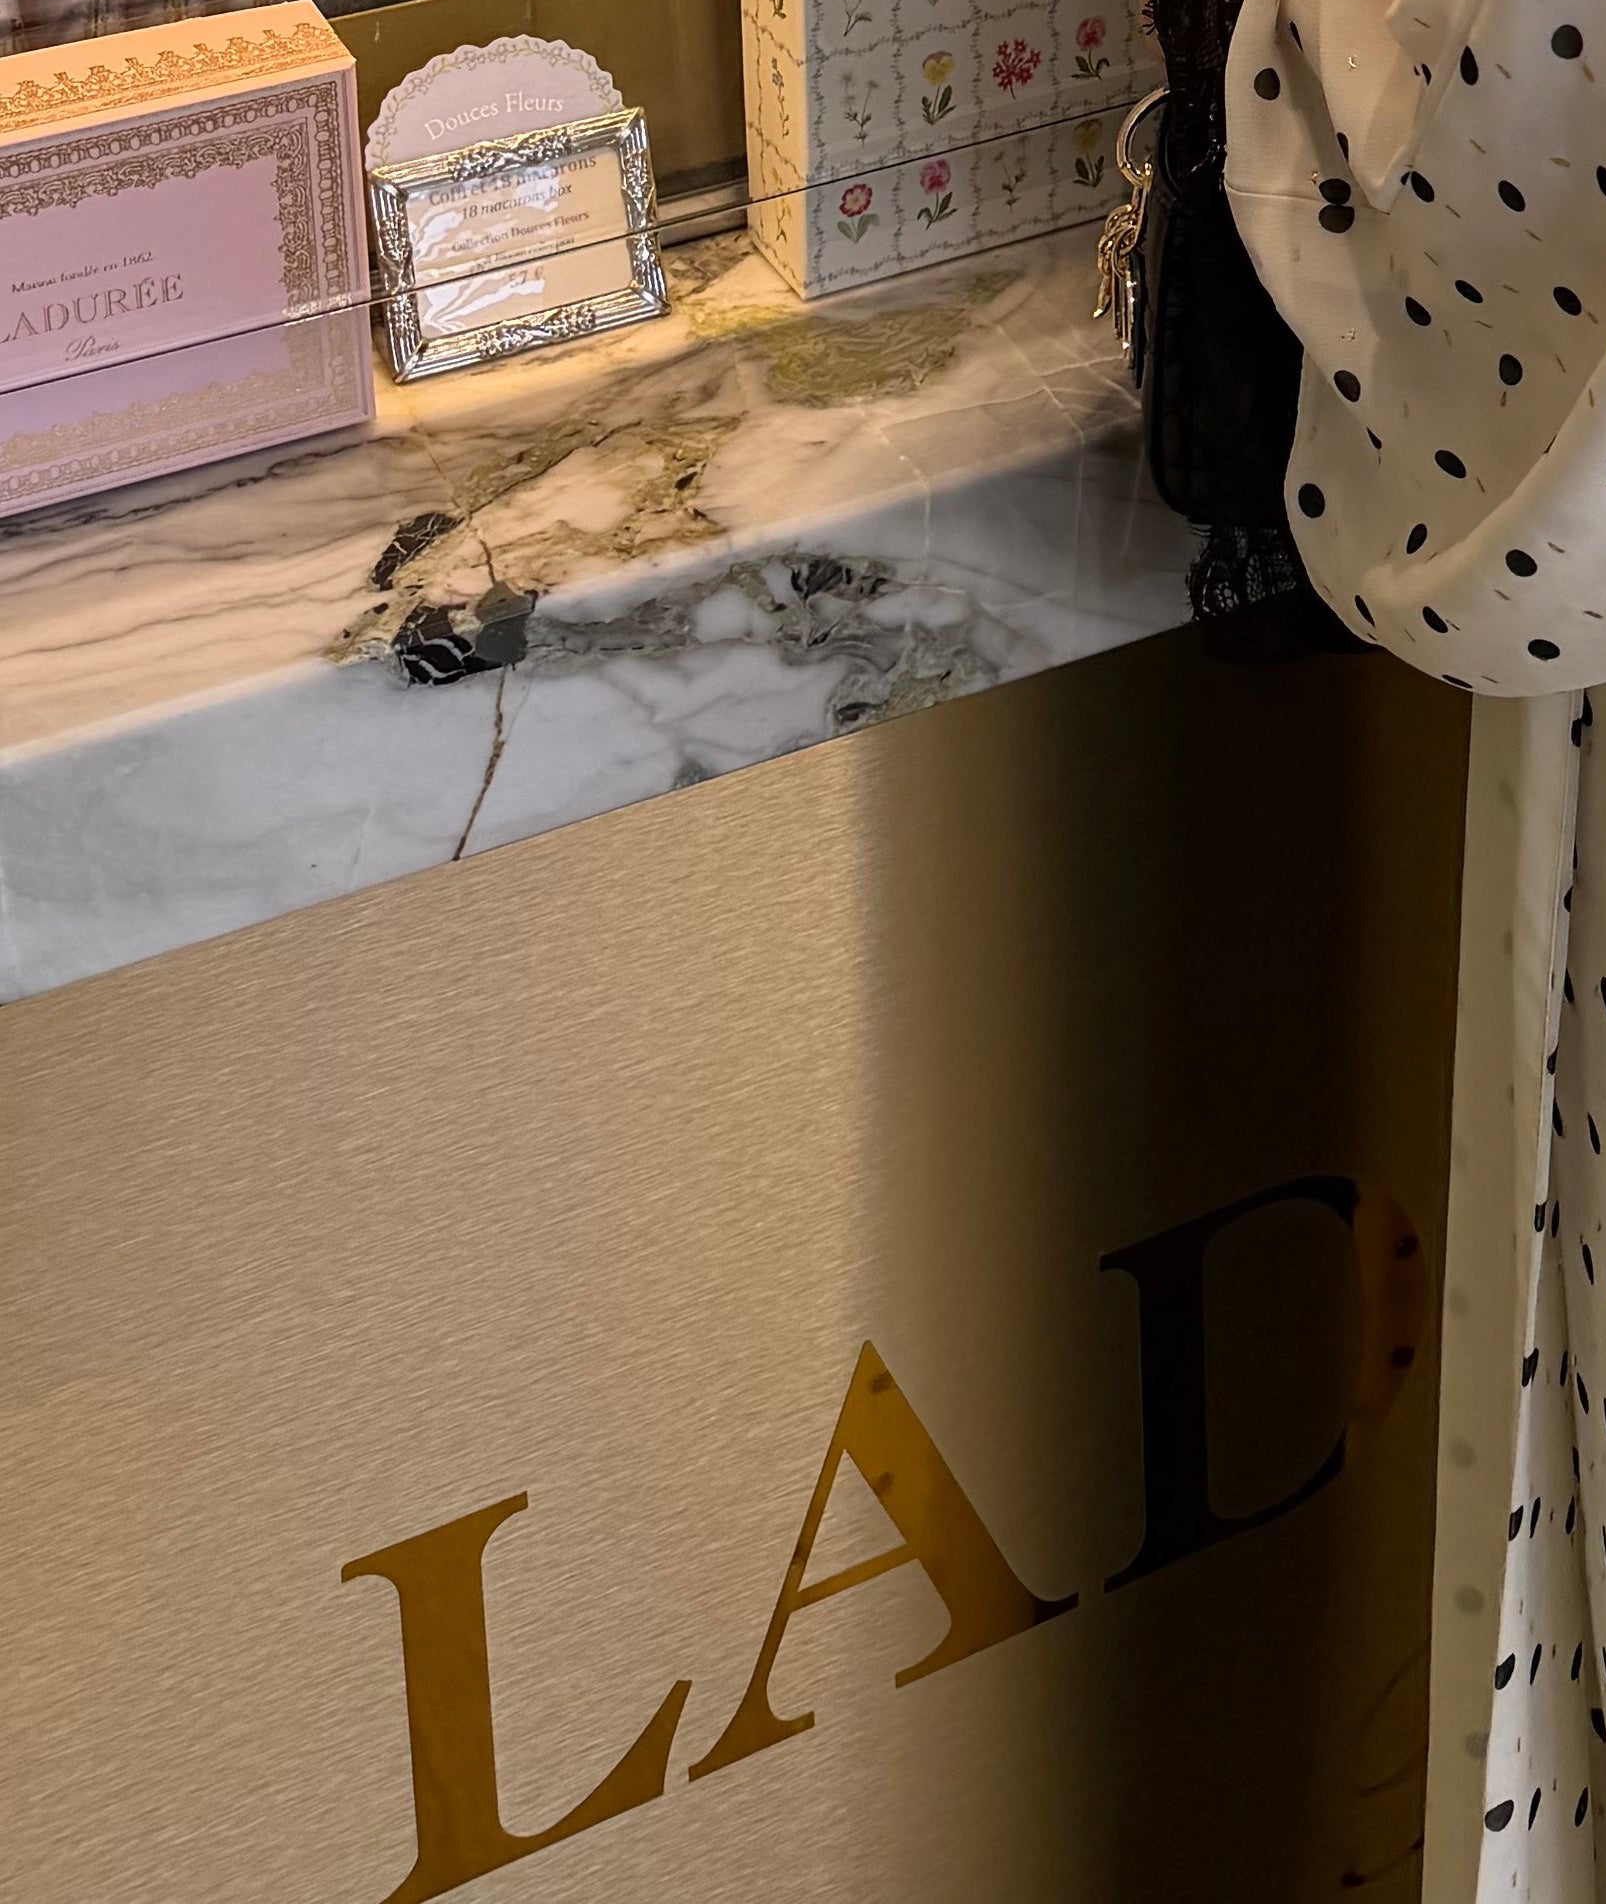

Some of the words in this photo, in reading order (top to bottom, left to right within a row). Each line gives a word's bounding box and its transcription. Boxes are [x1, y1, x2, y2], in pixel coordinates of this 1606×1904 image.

[424, 99, 500, 141] Douces
[504, 90, 565, 114] Fleurs
[463, 204, 478, 220] 18
[481, 191, 546, 215] macarons
[511, 222, 551, 238] Douces
[554, 212, 590, 227] Fleurs
[122, 252, 154, 267] 1862
[65, 335, 121, 361] Paris
[341, 1175, 1425, 1904] LAD
